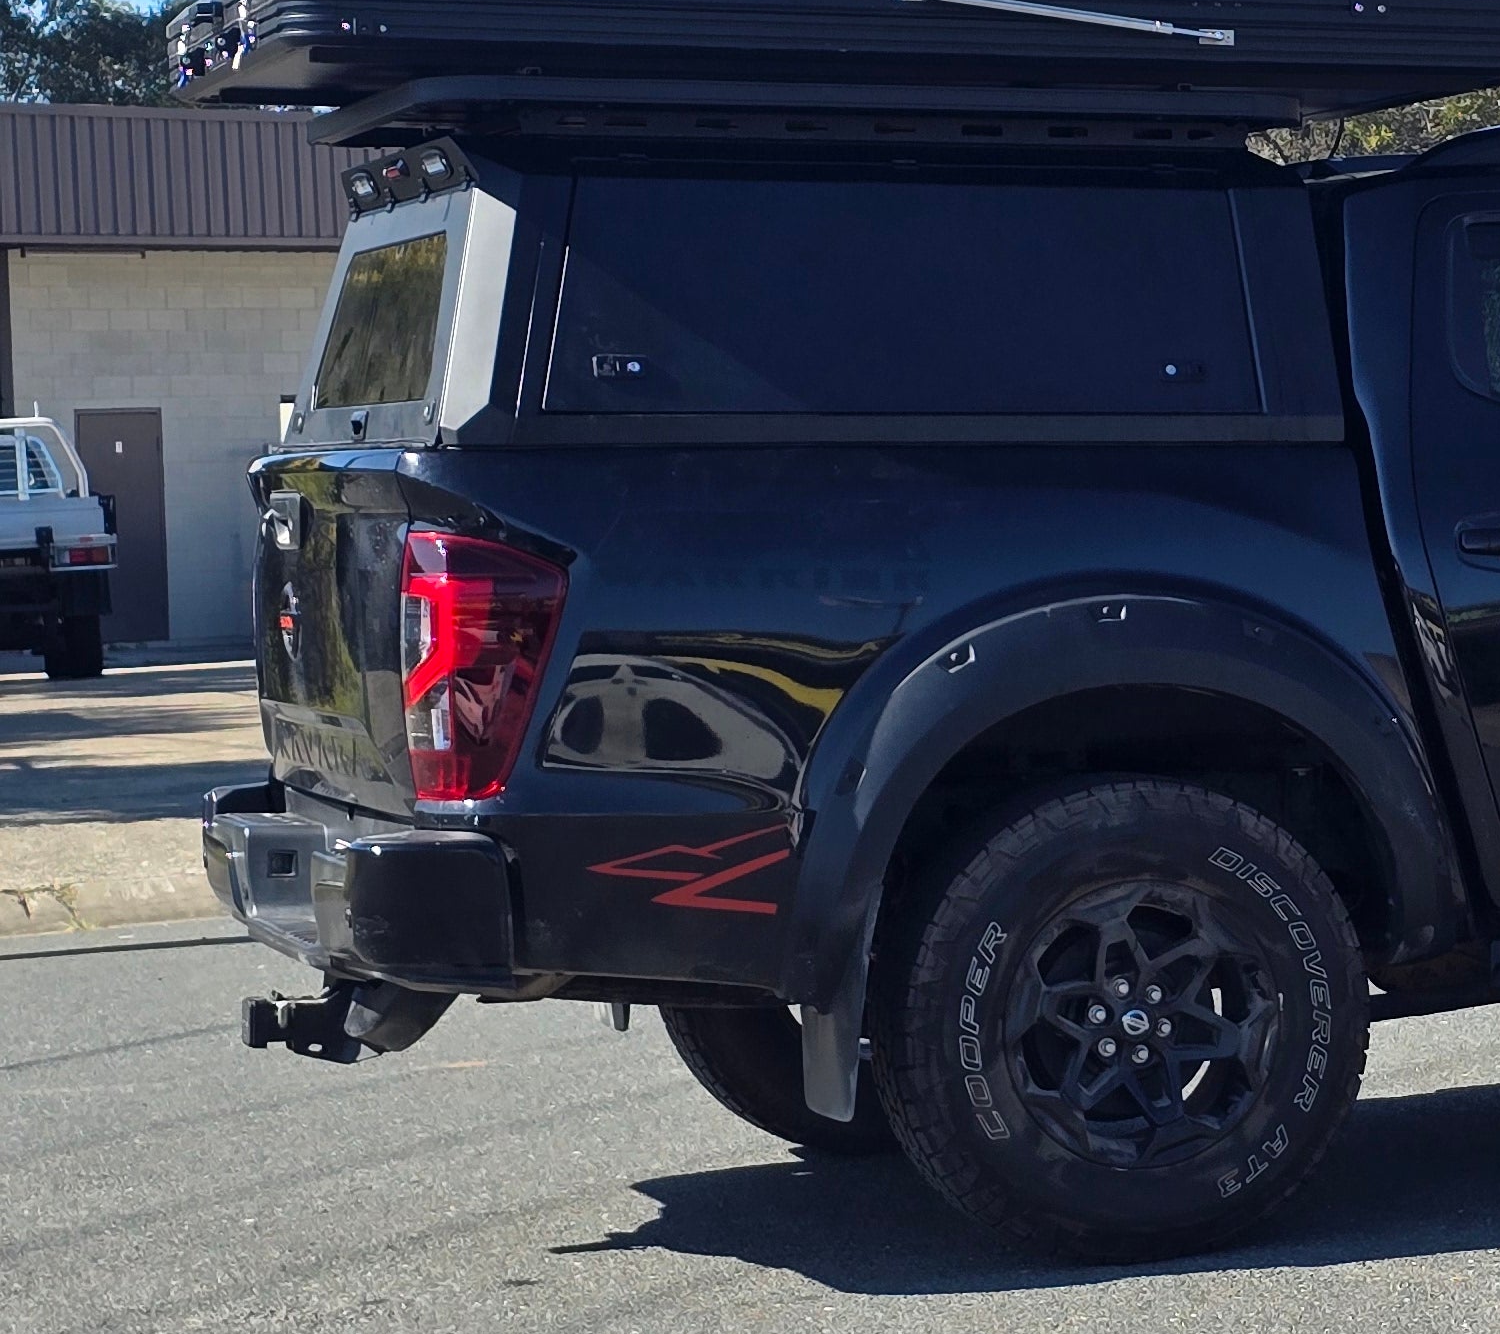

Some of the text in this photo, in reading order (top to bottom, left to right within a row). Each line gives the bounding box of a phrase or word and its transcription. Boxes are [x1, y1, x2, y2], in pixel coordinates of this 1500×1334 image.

[959, 921, 1011, 1140] COOPER
[1208, 846, 1332, 1198] DISCOVERER AT3
